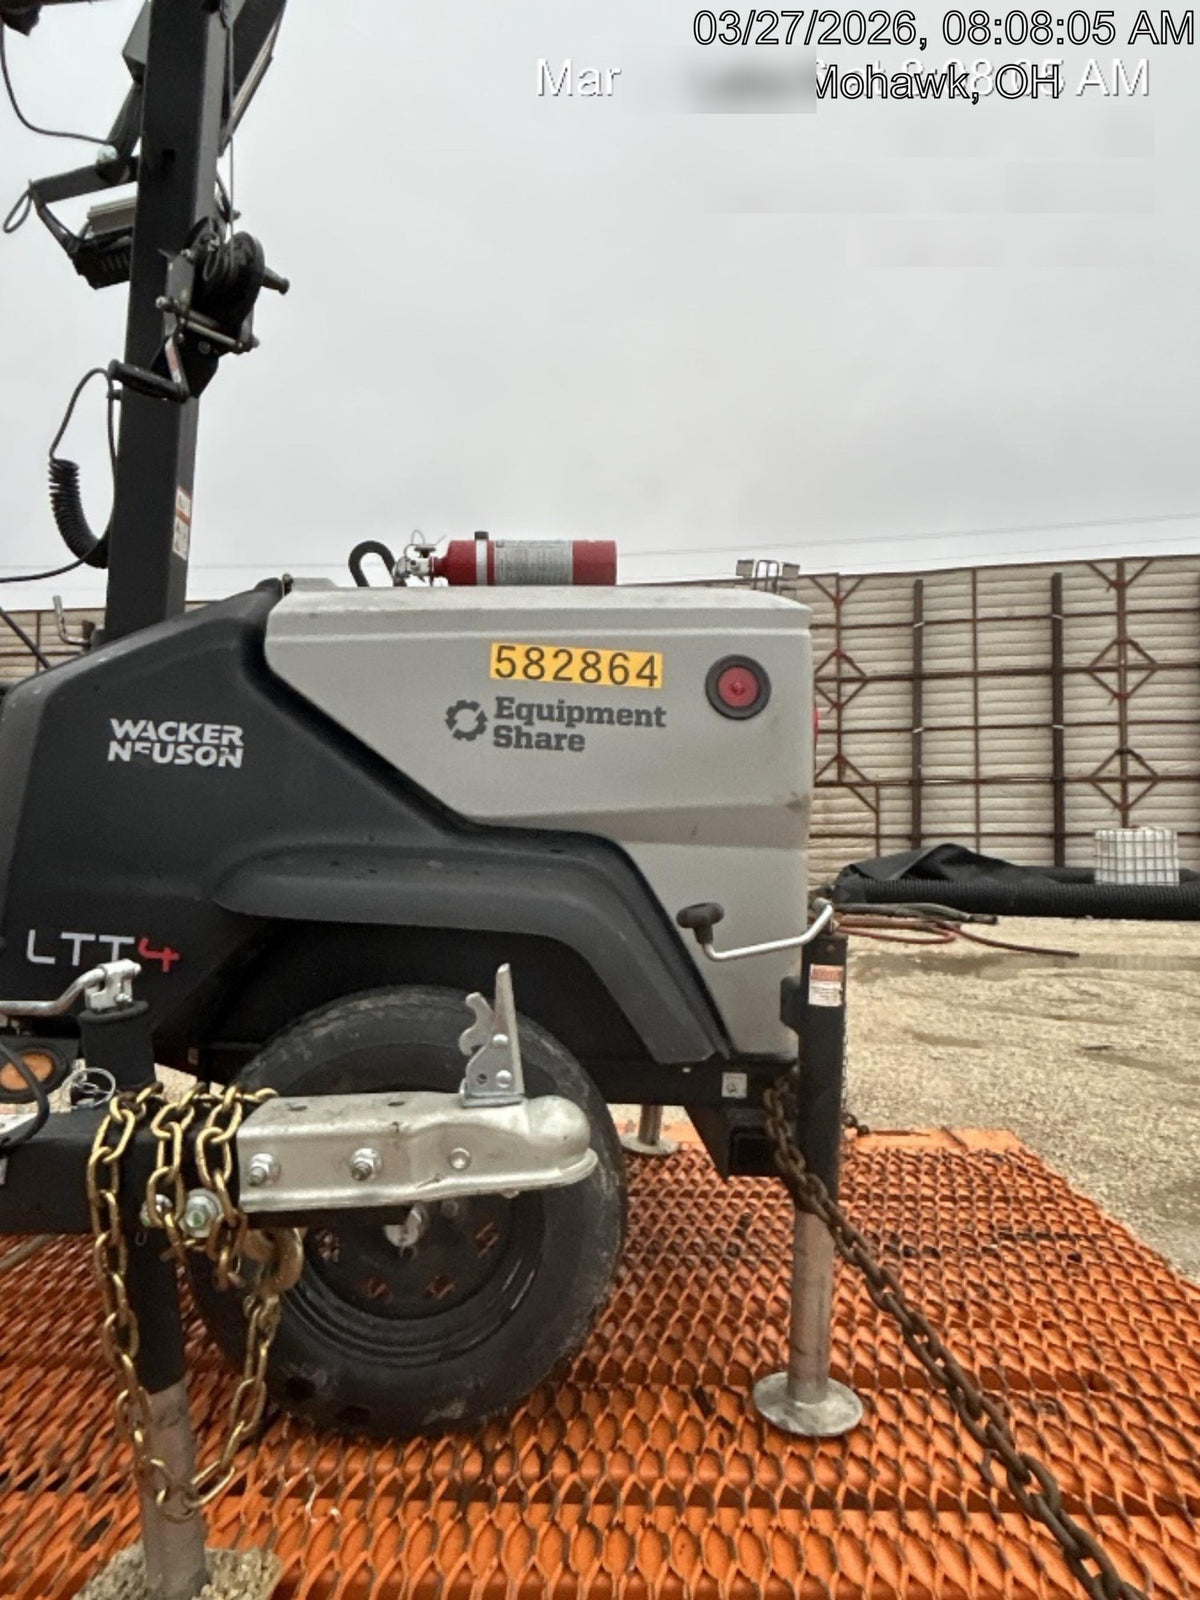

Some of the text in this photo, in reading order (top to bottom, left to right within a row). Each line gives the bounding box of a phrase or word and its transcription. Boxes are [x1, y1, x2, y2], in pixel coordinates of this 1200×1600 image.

[494, 645, 658, 687] 582864
[493, 696, 667, 729] Equipment
[109, 717, 245, 746] WACKER
[492, 724, 586, 752] Share
[26, 929, 180, 973] LTT4
